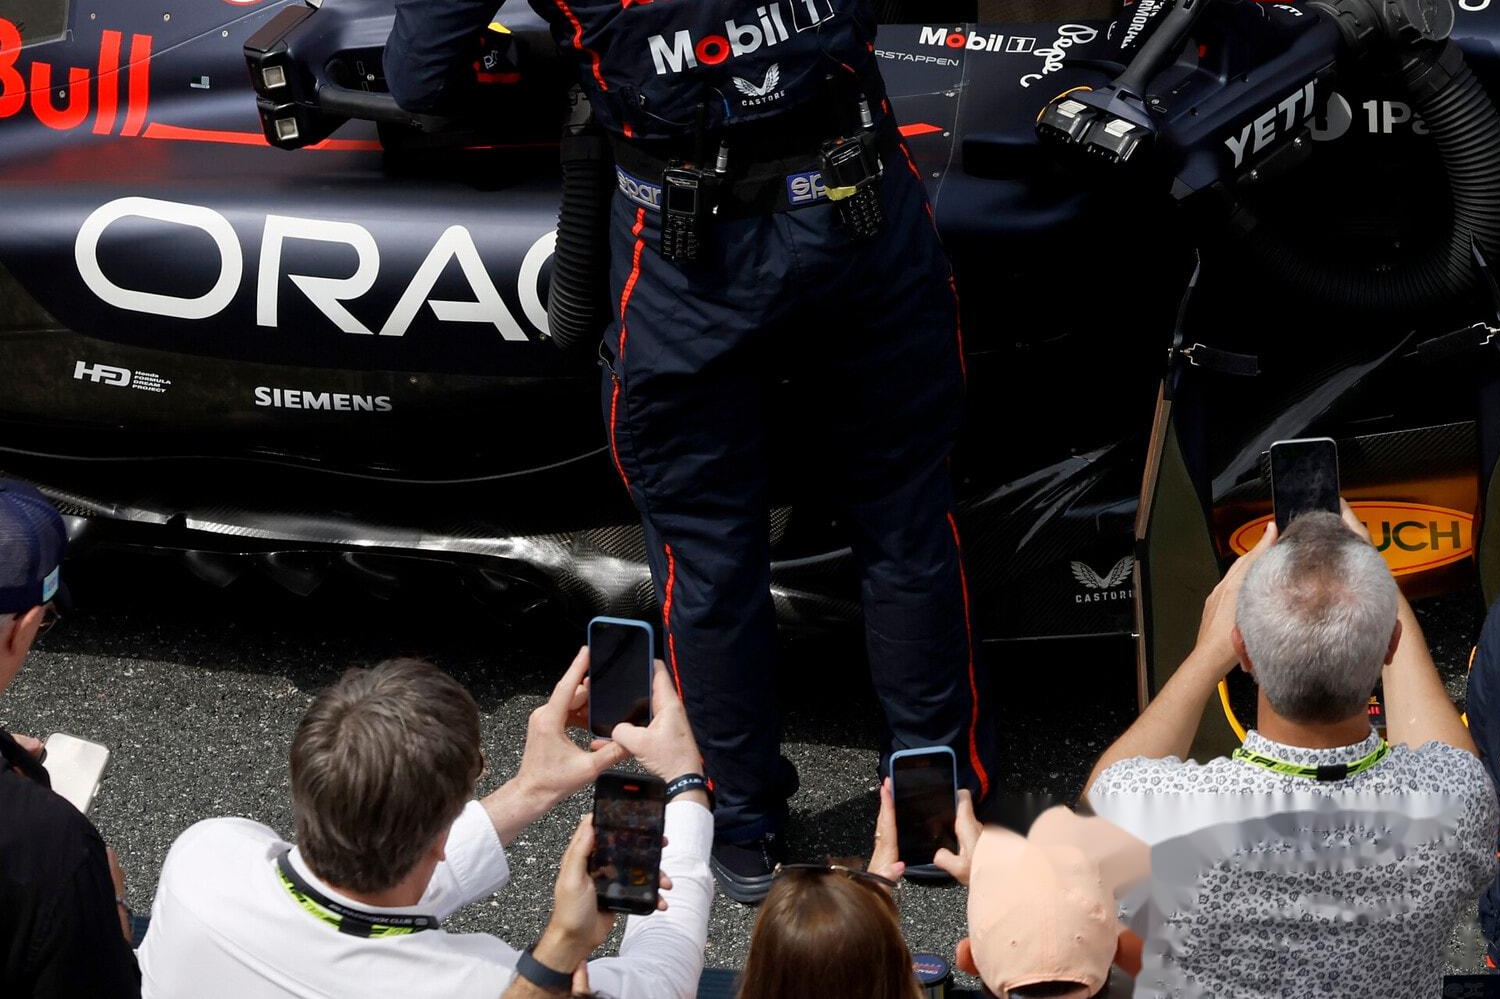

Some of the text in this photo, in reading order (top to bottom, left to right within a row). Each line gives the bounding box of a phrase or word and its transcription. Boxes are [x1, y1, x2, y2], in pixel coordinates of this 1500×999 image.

[647, 0, 789, 75] Mobil
[919, 26, 1004, 51] Mobil
[1033, 24, 1099, 75] Pepe
[874, 50, 960, 67] RSTAPPEN
[741, 88, 786, 106] CASTORE
[1224, 80, 1316, 169] YETI
[616, 169, 662, 211] spar
[75, 196, 558, 342] ORA
[132, 384, 167, 393] PROJECT
[133, 380, 161, 388] DREAM
[134, 375, 172, 385] FORMULA
[254, 386, 393, 412] SIEMENS
[1373, 521, 1461, 553] UCH
